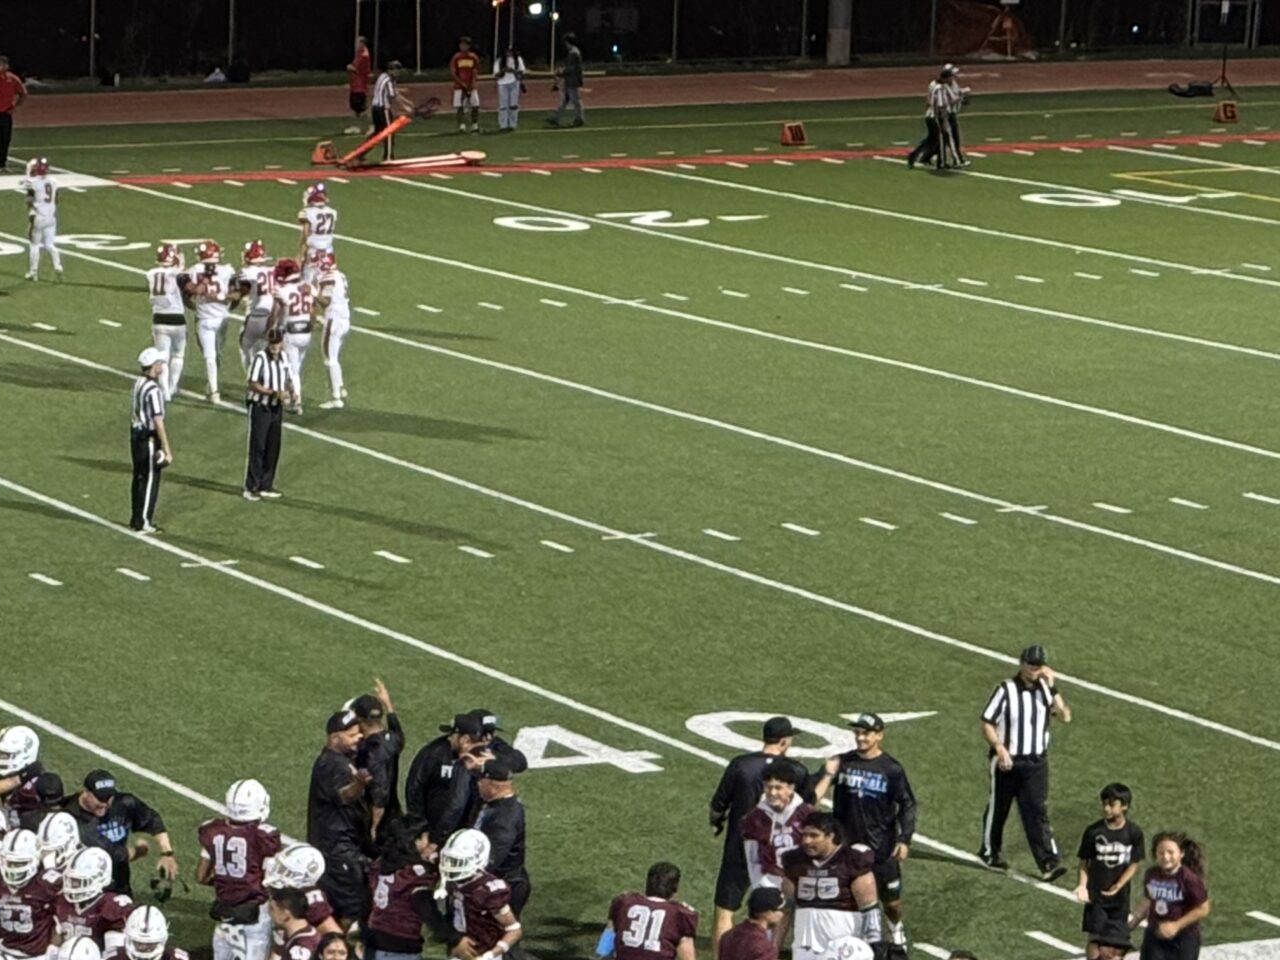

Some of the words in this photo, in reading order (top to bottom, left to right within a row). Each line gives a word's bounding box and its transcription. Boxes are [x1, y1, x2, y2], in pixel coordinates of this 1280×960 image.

[1223, 103, 1237, 120] G
[43, 182, 54, 203] 9
[315, 213, 334, 236] 27
[153, 272, 167, 296] 11
[288, 292, 311, 316] 26
[212, 834, 248, 879] 13
[622, 904, 668, 952] 31
